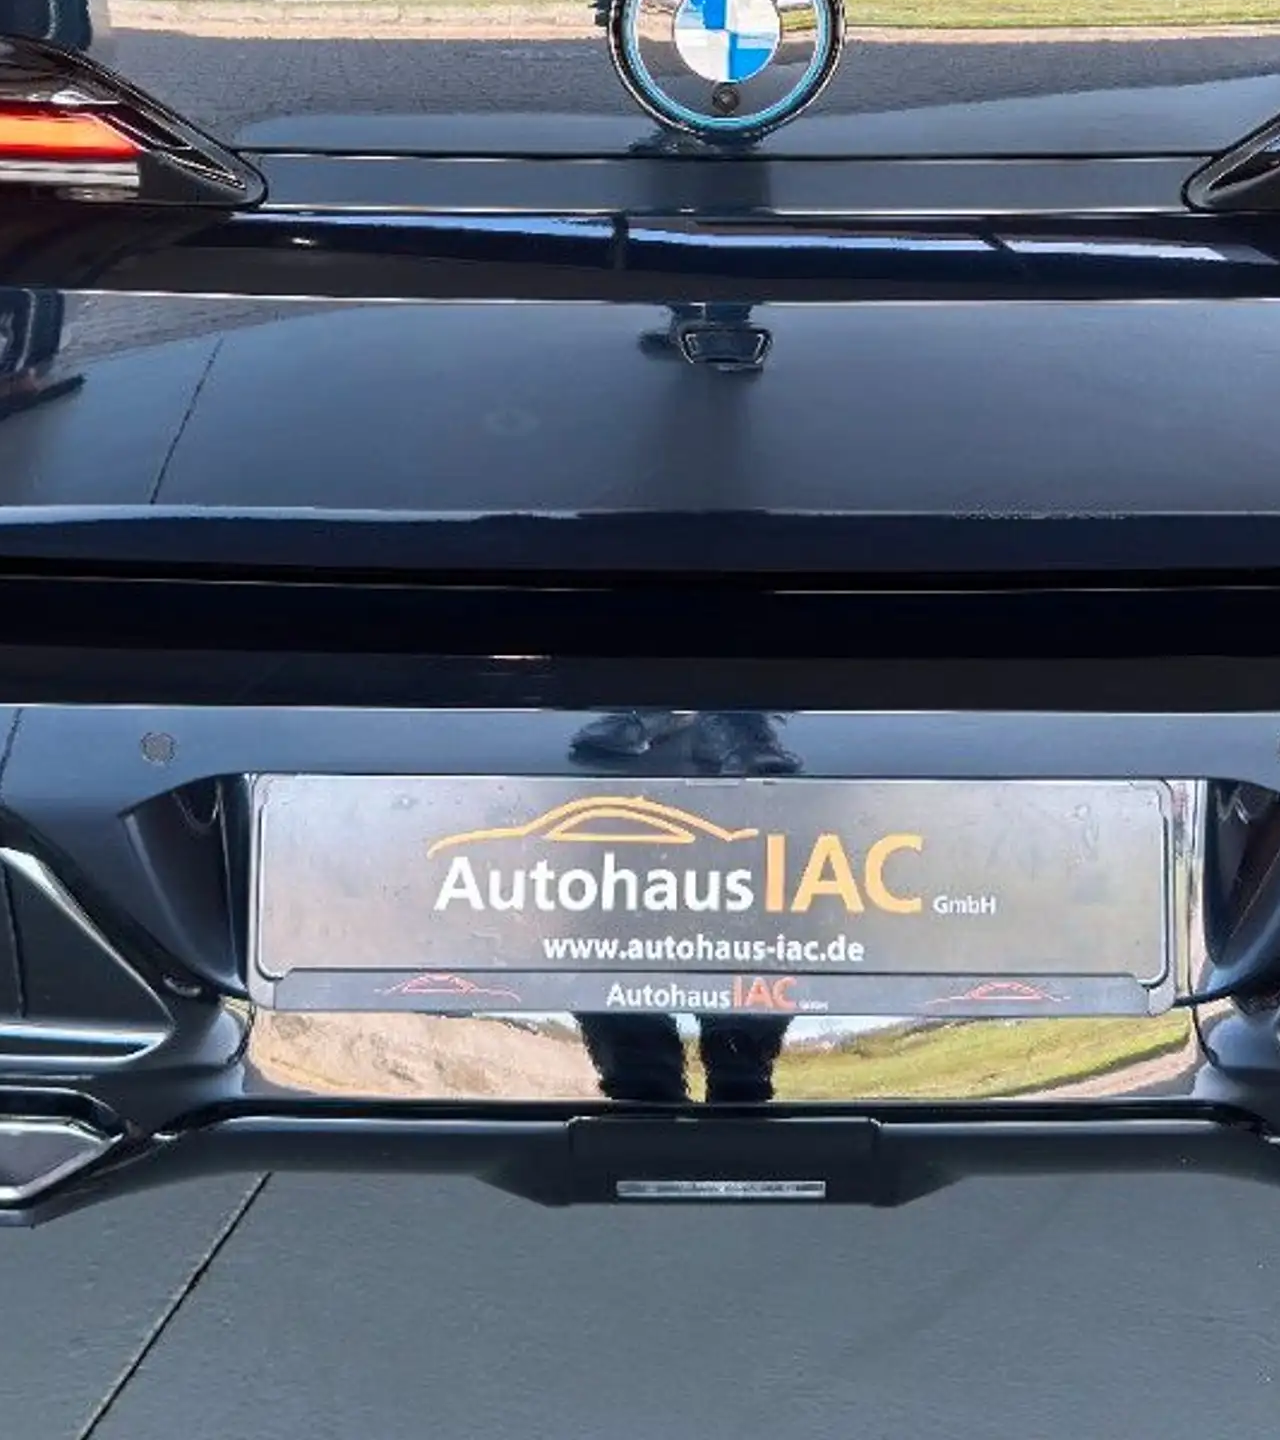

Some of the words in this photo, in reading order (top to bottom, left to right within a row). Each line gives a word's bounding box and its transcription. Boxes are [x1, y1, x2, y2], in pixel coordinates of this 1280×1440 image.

[433, 850, 754, 912] Autohaus
[765, 833, 925, 915] IAC
[932, 894, 997, 915] GmbH
[543, 934, 865, 962] www.autohaus-iac.de
[606, 978, 730, 1008] Autohaus
[733, 975, 797, 1009] IAC
